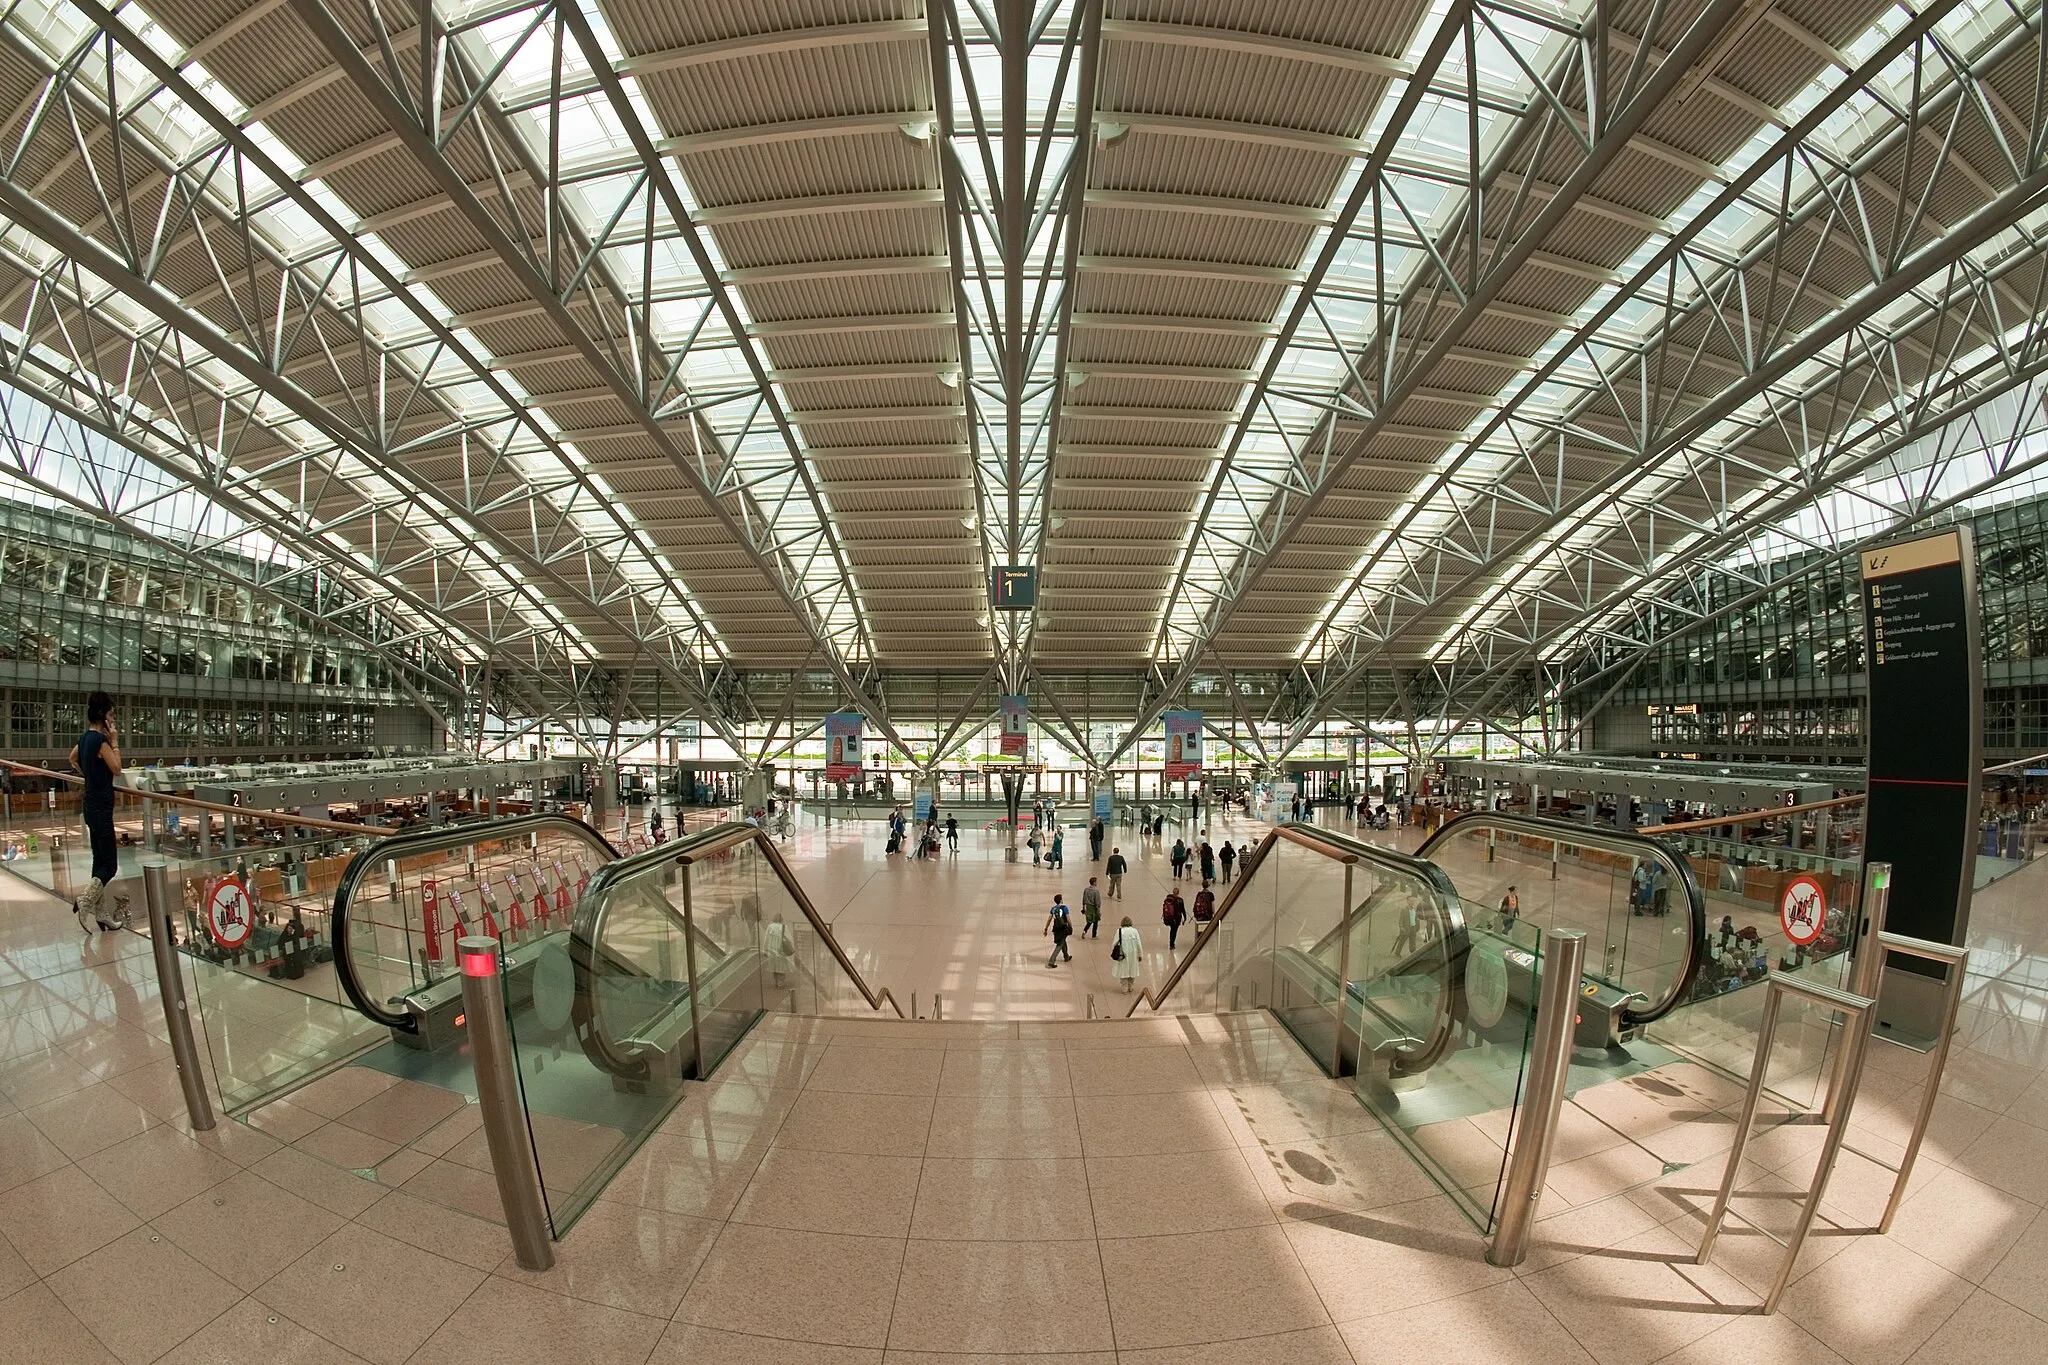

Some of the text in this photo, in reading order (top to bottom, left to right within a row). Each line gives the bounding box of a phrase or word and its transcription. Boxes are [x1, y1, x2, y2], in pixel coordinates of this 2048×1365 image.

[1004, 579, 1013, 597] 1
[582, 763, 588, 771] 2
[1438, 762, 1444, 771] 3
[233, 793, 239, 807] 2
[1787, 793, 1794, 806] 3
